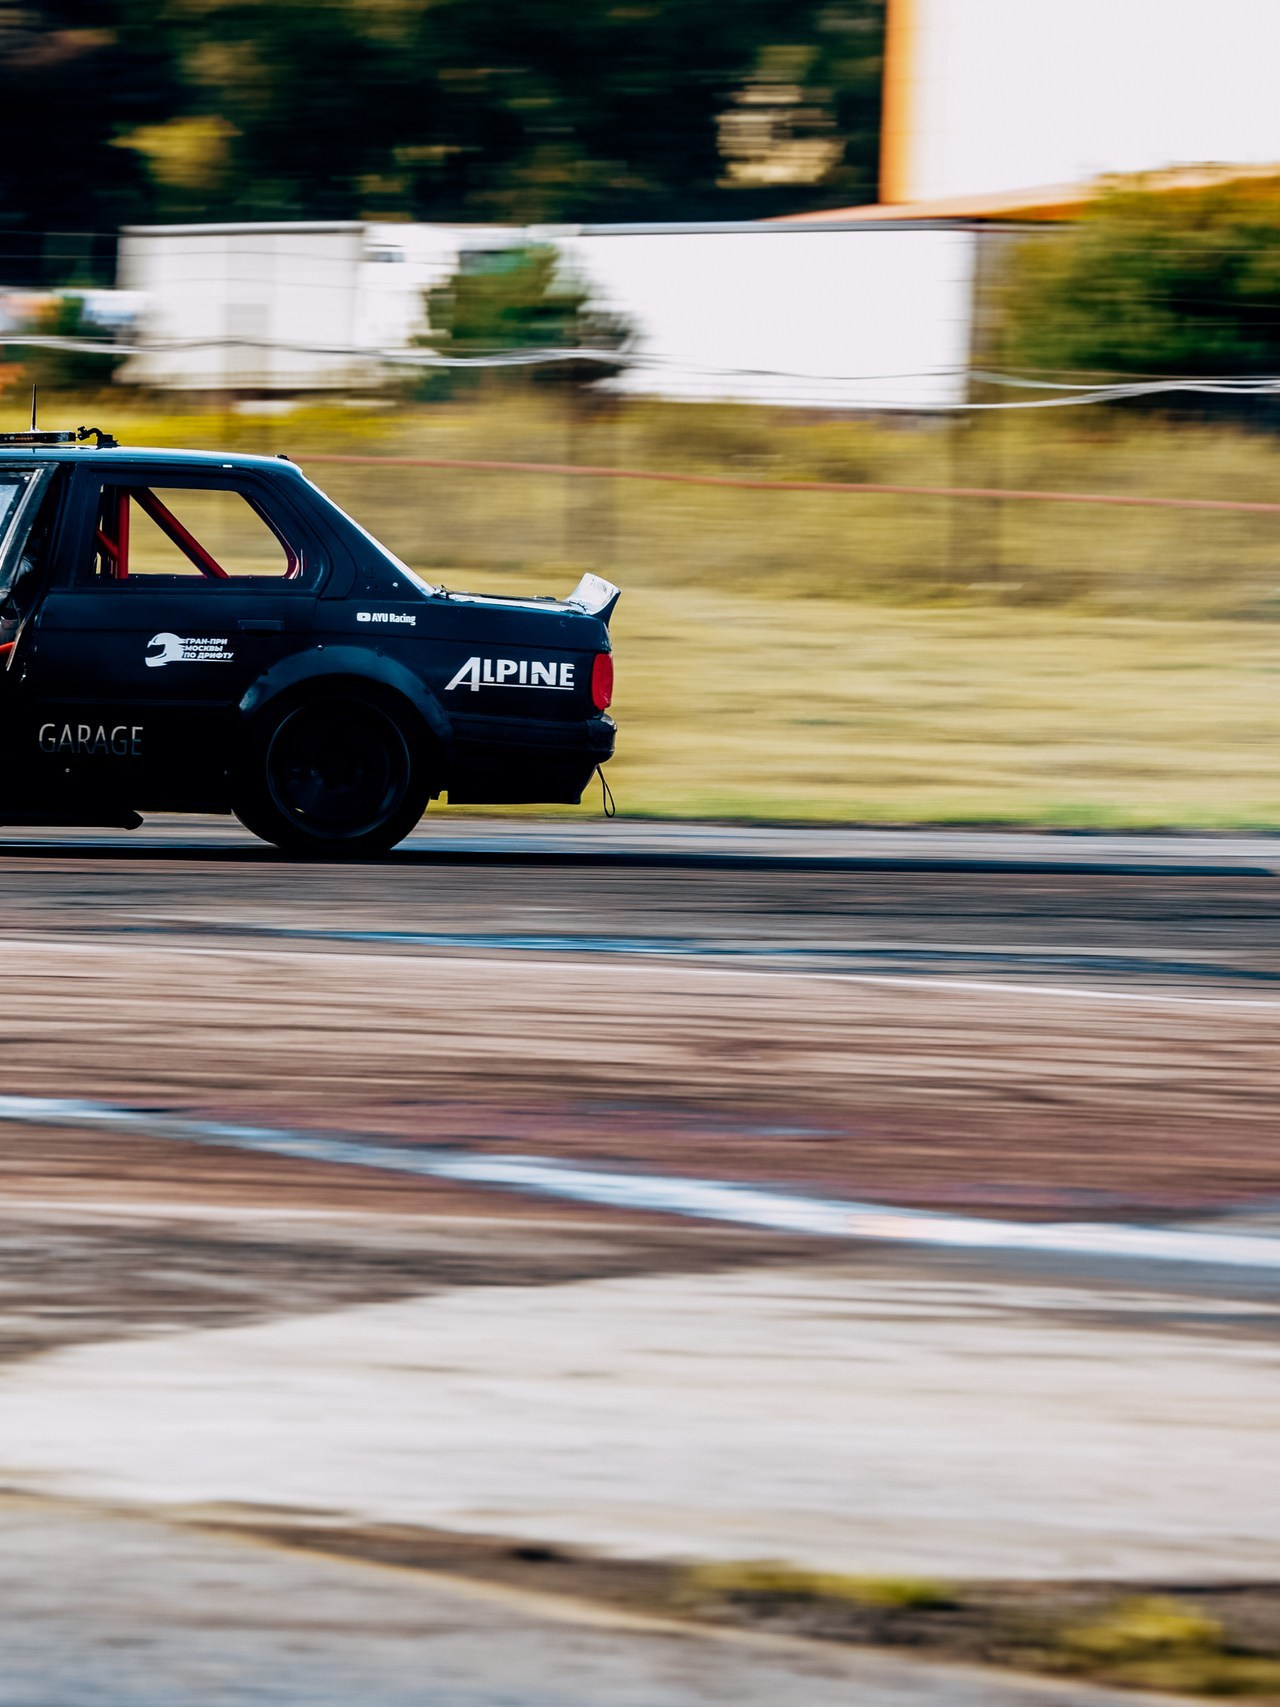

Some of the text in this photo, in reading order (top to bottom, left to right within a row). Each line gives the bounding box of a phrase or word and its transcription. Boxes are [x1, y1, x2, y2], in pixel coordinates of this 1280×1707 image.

[371, 612, 417, 626] AYU Racing
[184, 637, 229, 645] ГРАН-ПРИ
[183, 644, 224, 652] МОСКВЫ
[183, 651, 235, 660] ПО ДРИФТУ
[444, 656, 575, 692] ALPINE
[38, 723, 145, 756] GARAGE
